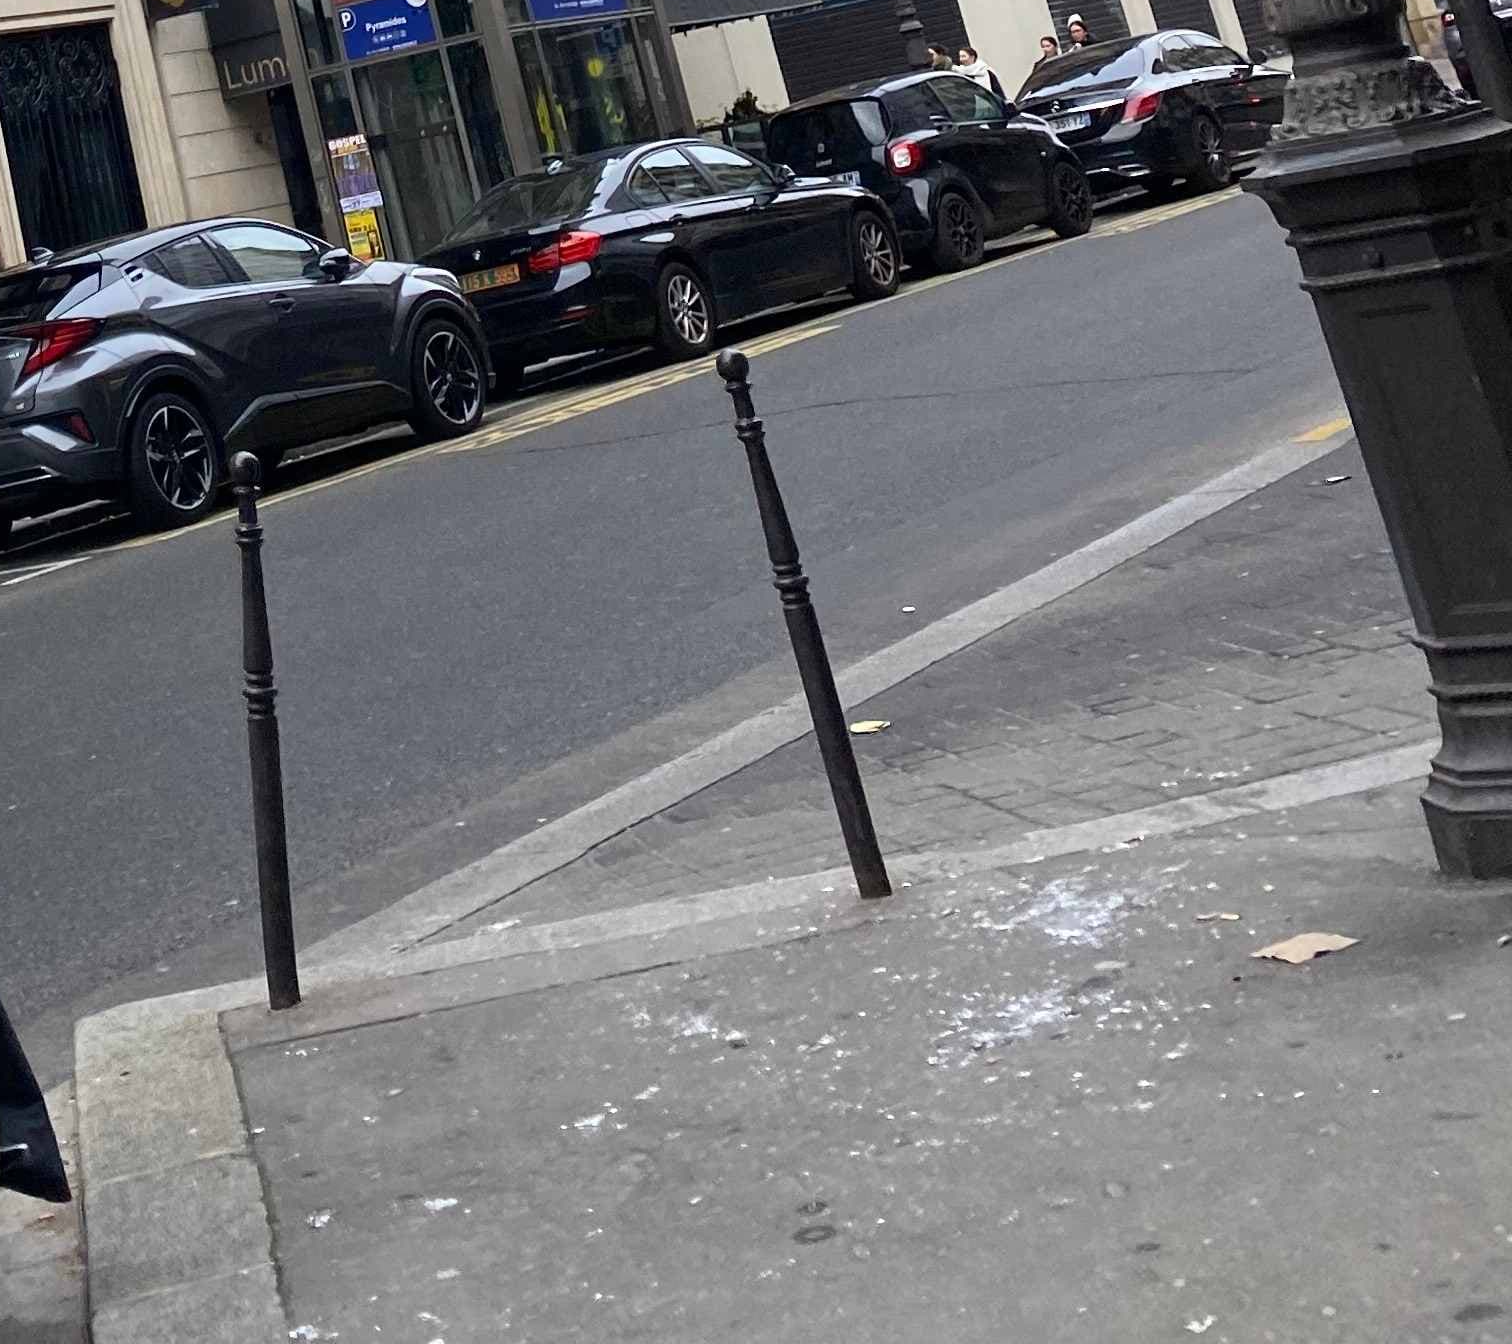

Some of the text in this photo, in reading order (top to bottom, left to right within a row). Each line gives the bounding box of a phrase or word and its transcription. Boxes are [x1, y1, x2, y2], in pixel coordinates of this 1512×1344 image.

[341, 11, 352, 28] P
[365, 16, 407, 34] Pyramides
[328, 134, 367, 151] GOSPEL
